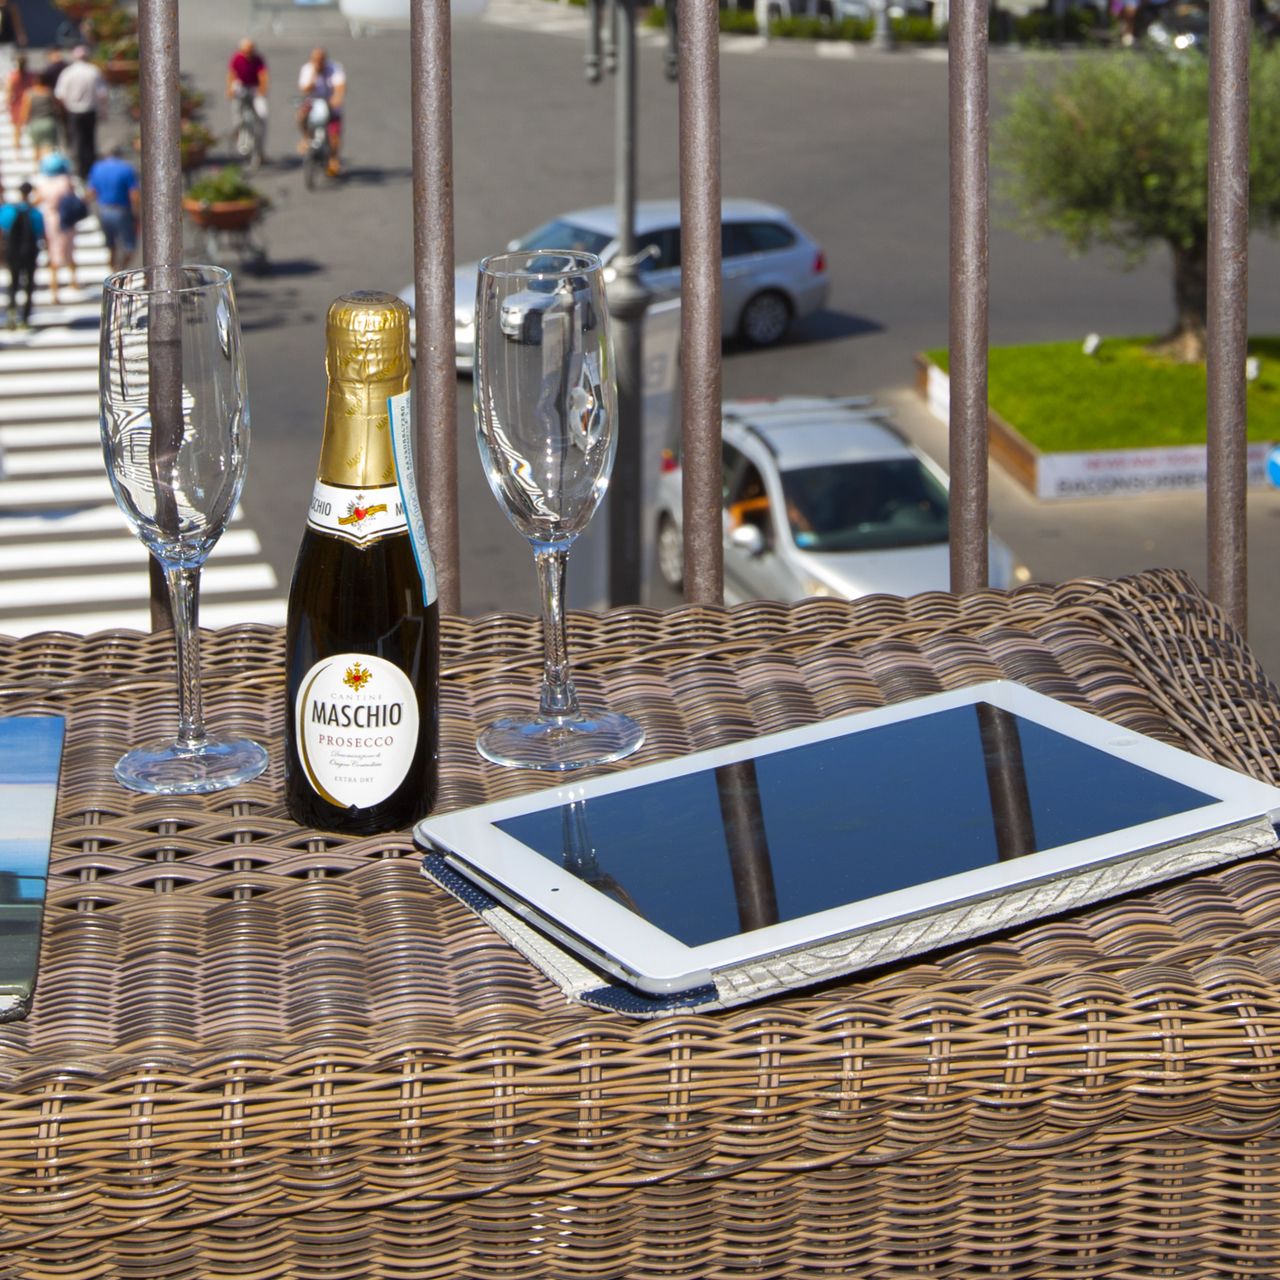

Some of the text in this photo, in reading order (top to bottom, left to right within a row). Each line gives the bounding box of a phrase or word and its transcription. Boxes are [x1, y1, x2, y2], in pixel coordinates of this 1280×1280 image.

[330, 692, 382, 701] CANTINE
[312, 700, 402, 728] MASCHIO
[319, 733, 394, 748] PROSECCO
